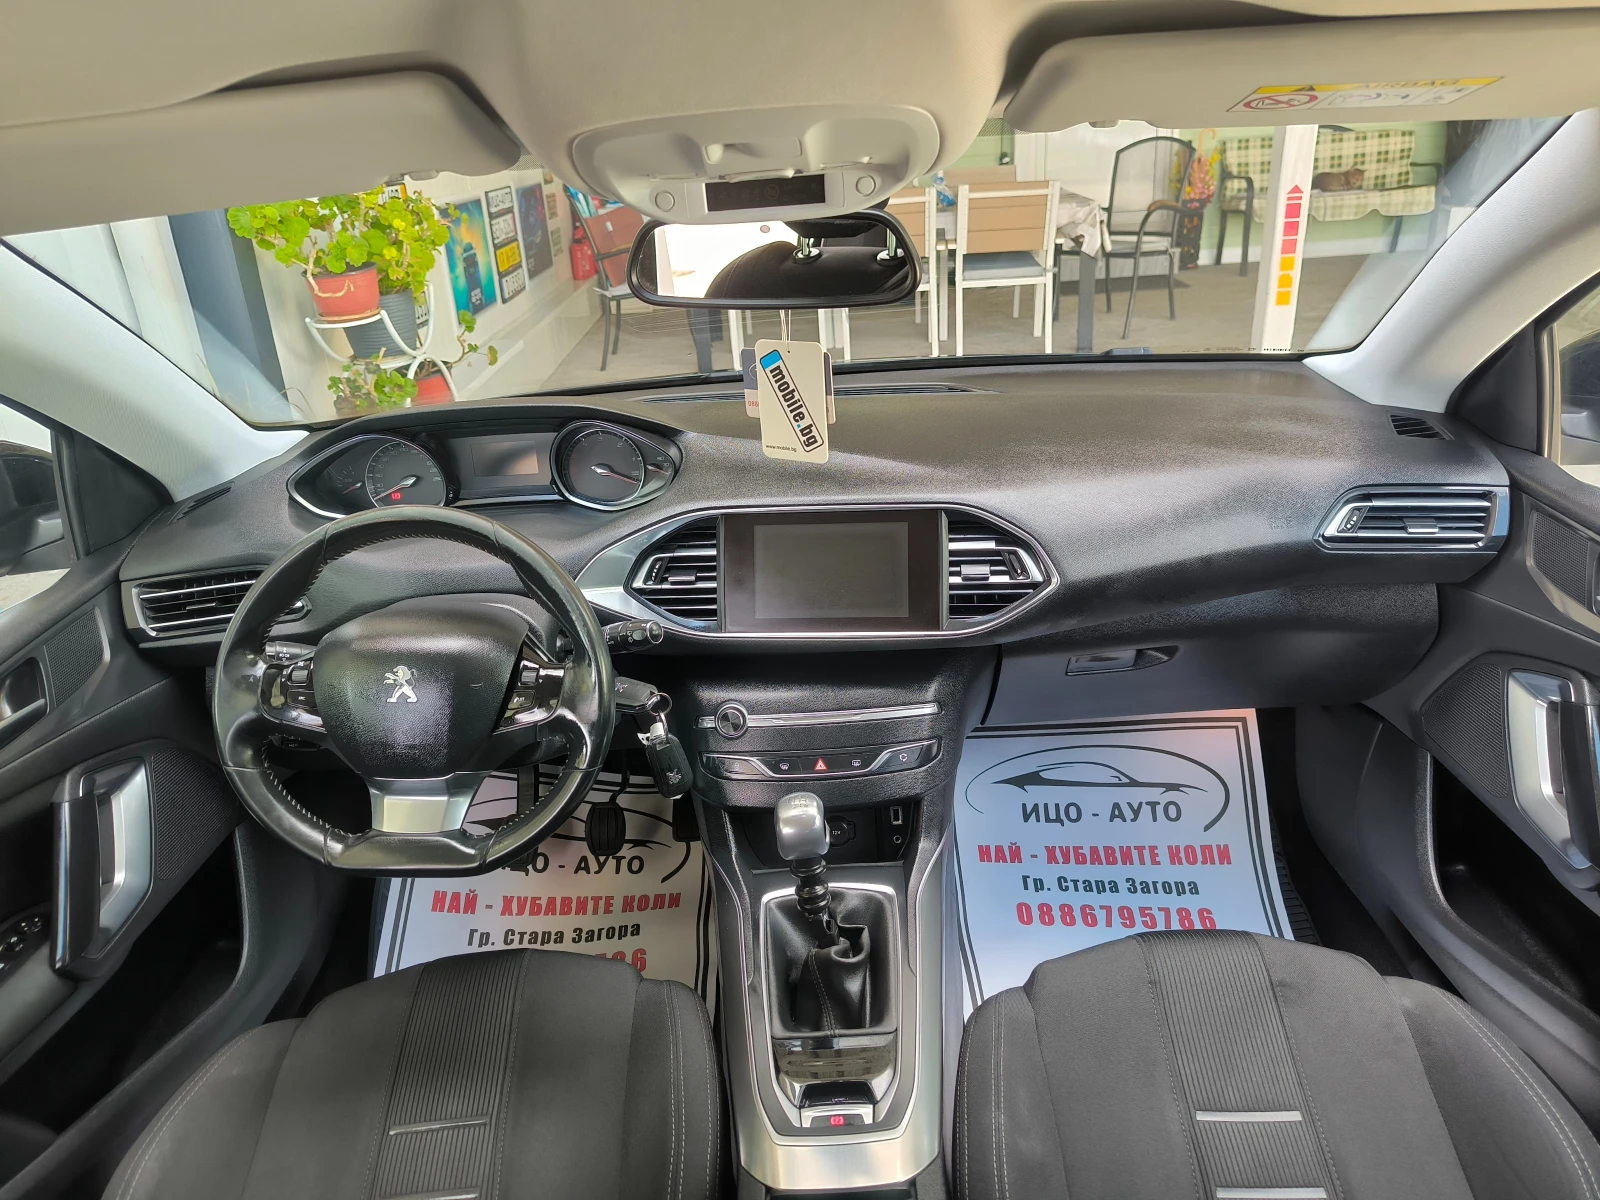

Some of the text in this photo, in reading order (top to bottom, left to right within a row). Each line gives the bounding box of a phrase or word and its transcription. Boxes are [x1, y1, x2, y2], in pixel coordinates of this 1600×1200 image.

[769, 364, 818, 448] mobile.bg
[765, 443, 797, 453] www.mobile.bg
[1021, 801, 1082, 827] ИЦО
[1109, 801, 1182, 823] АУТО
[573, 854, 646, 875] АУТО
[978, 842, 1022, 864] НАЙ
[1046, 846, 1161, 866] ХУБАВИТЕ
[1168, 845, 1232, 866] КОЛИ
[1022, 875, 1200, 896] Гр. Стара Загора
[431, 889, 478, 914] НАЙ
[500, 896, 613, 917] ХУБАВИТЕ
[621, 892, 682, 913] КОЛИ
[1016, 902, 1217, 931] 0886795786
[467, 923, 641, 948] Гр. Стара Загора
